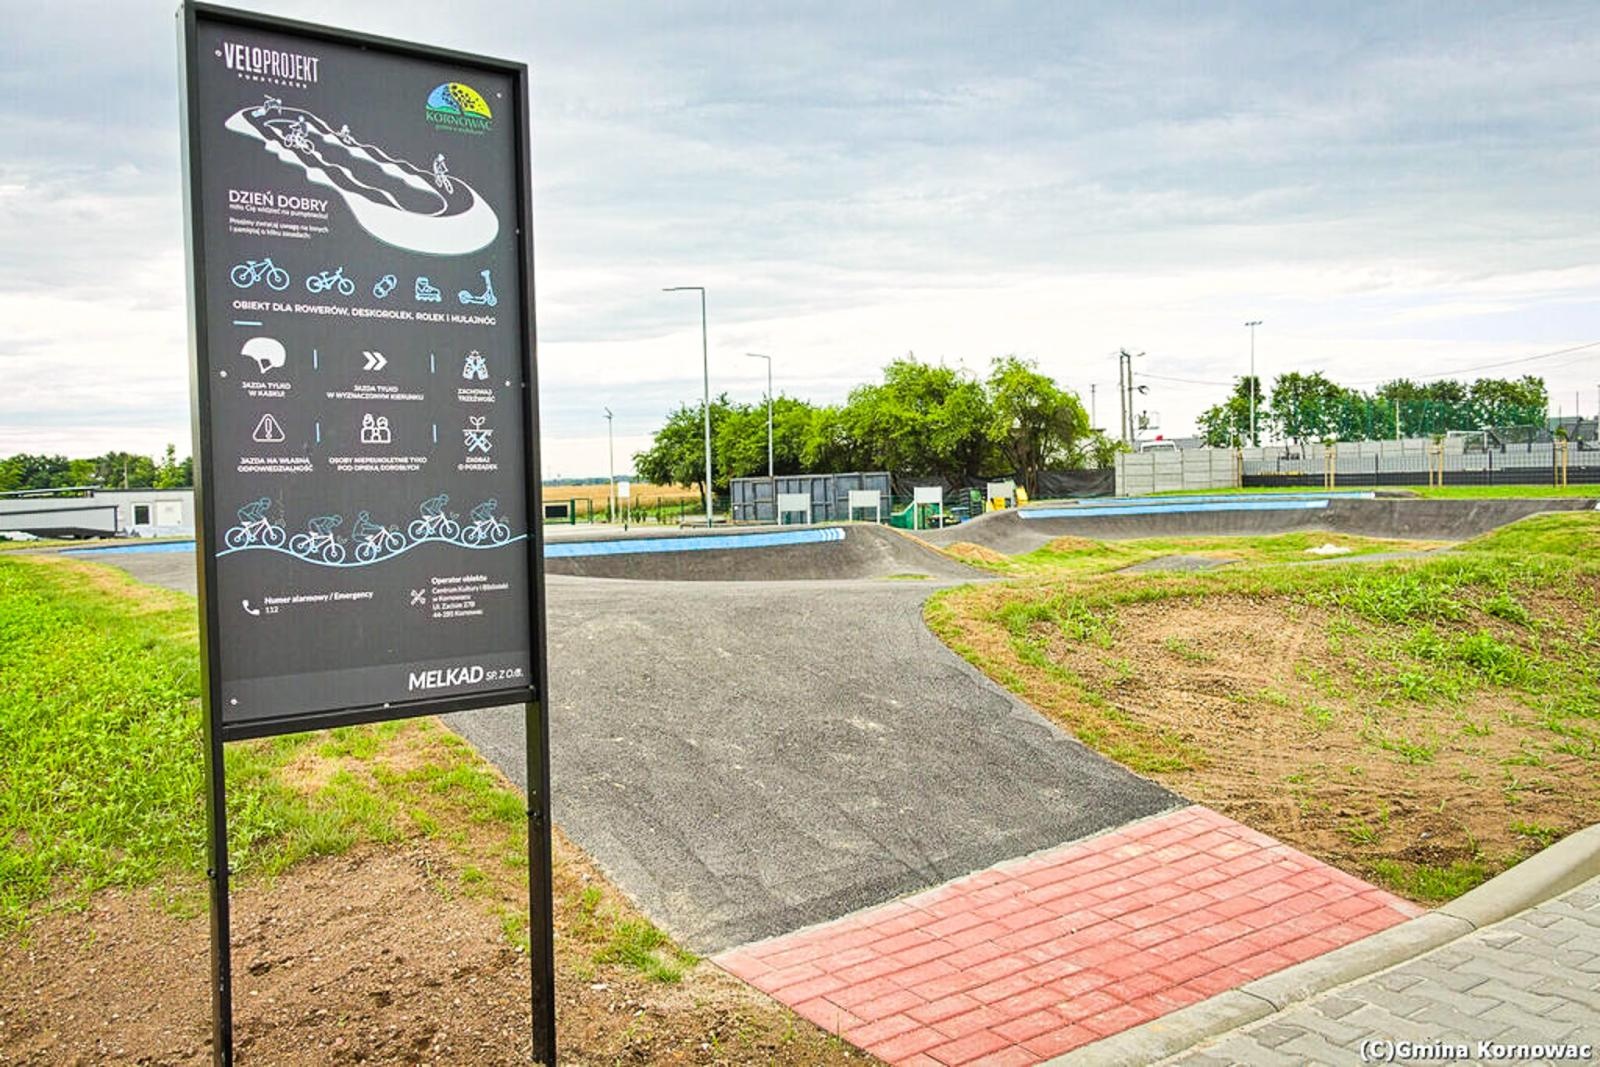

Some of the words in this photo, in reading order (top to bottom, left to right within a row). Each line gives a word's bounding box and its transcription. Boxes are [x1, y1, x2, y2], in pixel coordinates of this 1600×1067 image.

[224, 42, 319, 82] VELOPROJEKT
[425, 111, 492, 131] KORNOWAC
[229, 190, 274, 206] DZIEŃ
[277, 195, 328, 212] DOBRY
[232, 300, 270, 311] OBIEKT
[273, 302, 292, 312] DLA
[416, 312, 445, 322] ROLEK
[242, 381, 267, 389] JAZDA
[267, 382, 291, 390] TYLKO
[354, 384, 376, 392] JAZDA
[377, 385, 398, 393] TYLKO
[248, 389, 257, 397] W
[326, 391, 334, 399] W
[240, 457, 265, 465] JAZDA
[266, 457, 278, 465] NA
[328, 457, 352, 465] OSOBY
[337, 464, 353, 472] POD
[431, 576, 461, 585] Operator
[334, 591, 374, 601] Emergency
[265, 605, 279, 614] 112
[408, 666, 484, 691] MELKAD
[499, 670, 505, 679] Z
